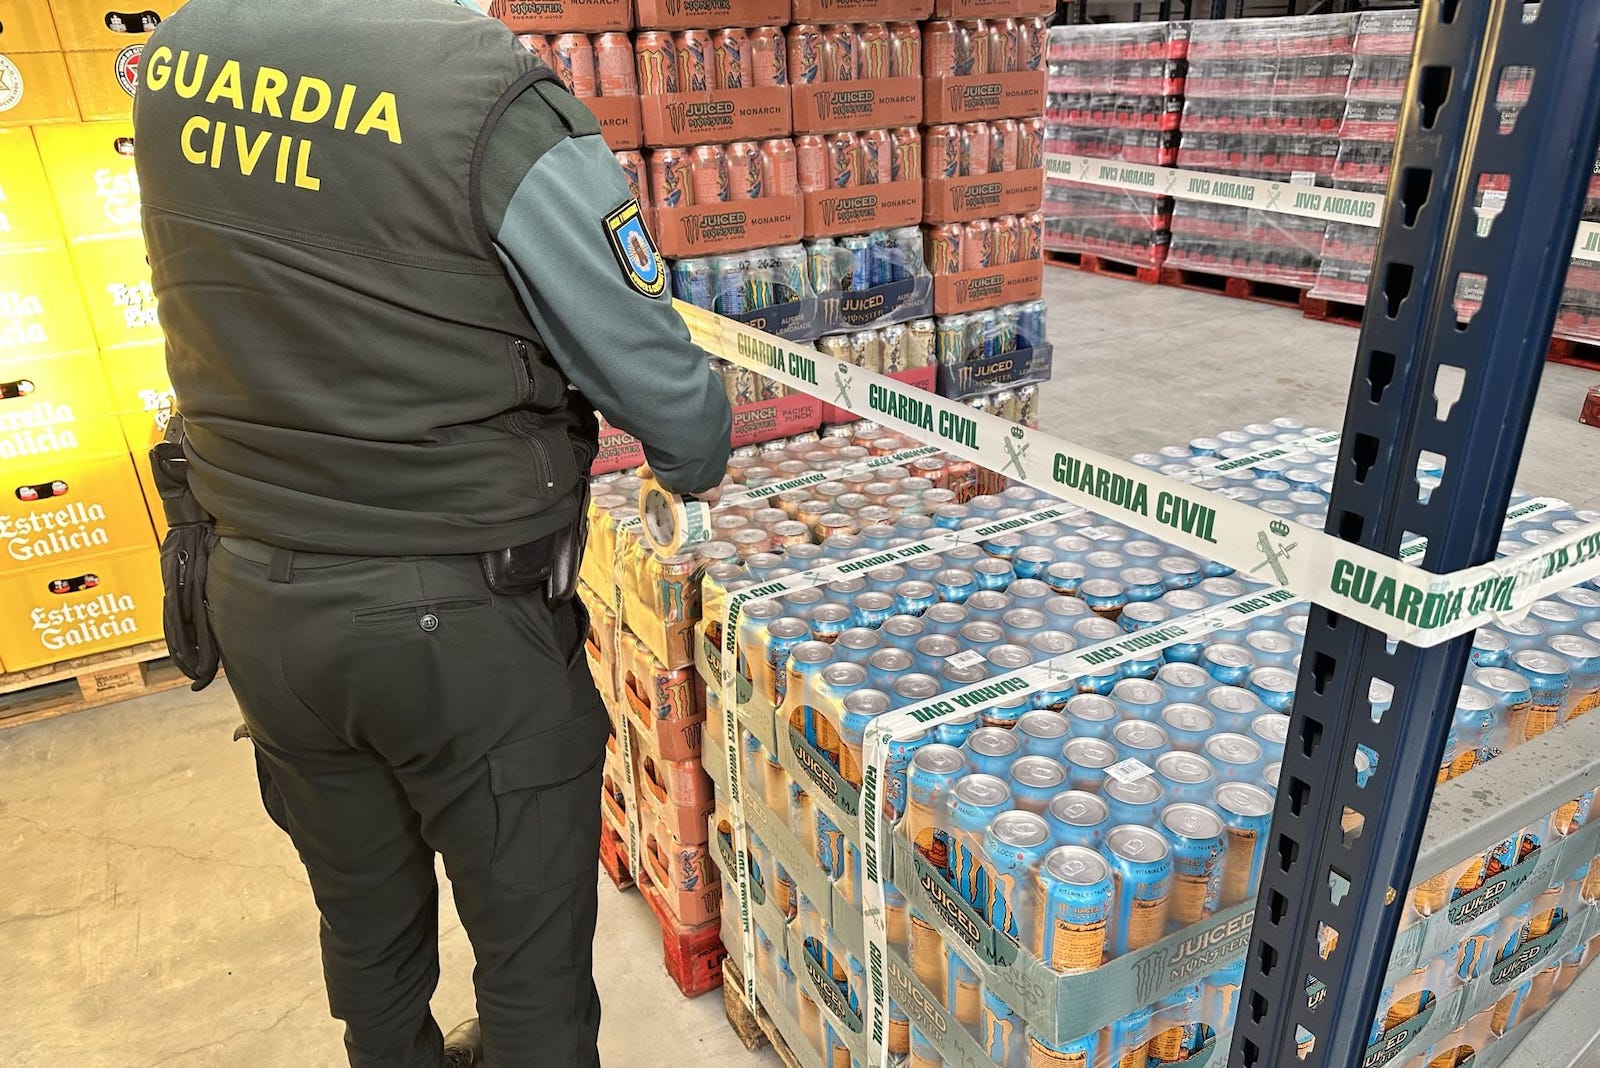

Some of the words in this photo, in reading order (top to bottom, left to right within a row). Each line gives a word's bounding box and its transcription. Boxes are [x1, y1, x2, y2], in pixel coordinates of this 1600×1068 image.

[510, 3, 564, 14] MONSTER
[146, 46, 402, 144] GUARDIA
[831, 90, 874, 104] JUICED
[879, 96, 916, 104] MONARCH
[963, 84, 1002, 98] JUICED
[1006, 89, 1039, 97] MONARCH
[685, 102, 735, 116] JUICED
[740, 106, 781, 116] MONARCH
[688, 117, 733, 128] MONSTER
[180, 115, 321, 191] CIVIL
[965, 183, 1002, 197] JUICED
[1006, 186, 1038, 195] MONARCH
[837, 196, 877, 211] JUICED
[882, 199, 917, 208] MONARCH
[700, 212, 746, 228] JUICED
[752, 215, 791, 225] MONARCH
[968, 274, 1004, 290] JUICED
[1007, 276, 1038, 286] MONARCH
[842, 295, 884, 311] JUICED
[891, 299, 925, 311] LEMONADE
[781, 313, 805, 325] AUSSIE
[843, 309, 884, 324] MONSTER
[775, 322, 812, 336] LEMONADE
[736, 332, 786, 373] GUARDIA
[788, 352, 818, 386] CIVIL
[974, 360, 1014, 377] JUICED
[734, 407, 777, 425] PUNCH
[783, 405, 814, 417] PACIFIC
[785, 413, 812, 423] PUNCH
[869, 383, 934, 432] GUARDIA
[938, 413, 980, 450] CIVIL
[746, 488, 777, 499] CIVIL
[777, 473, 828, 493] GUARDIA
[1052, 452, 1149, 518] GUARDIA
[1155, 490, 1218, 544] CIVIL
[0, 502, 107, 539] Estrella
[975, 517, 1029, 536] GUARDIA
[1030, 509, 1065, 524] CIVIL
[8, 525, 110, 561] Galicia
[837, 550, 898, 575] GUARDIA
[898, 543, 935, 558] CIVIL
[1227, 594, 1271, 615] CIVIL
[1330, 558, 1466, 630] GUARDIA
[1467, 576, 1518, 616] CIVIL
[31, 593, 136, 631] Estrella
[726, 593, 752, 655] GUARDIA
[750, 582, 791, 599] CIVIL
[41, 615, 139, 650] Galicia
[1122, 624, 1190, 651] GUARDIA
[1076, 644, 1122, 666] CIVIL
[952, 676, 1030, 708] GUARDIA
[906, 701, 955, 723] CIVIL
[796, 747, 838, 794] JUICED
[864, 764, 877, 843] GUARDIA
[864, 843, 879, 884] CIVIL
[921, 875, 982, 943] JUICED
[1171, 910, 1256, 963] JUICED
[1169, 933, 1250, 982] MONSTER
[869, 940, 883, 1007] GUARDIA
[806, 963, 846, 1018] JUICED
[888, 960, 947, 1033] JUICED
[871, 1005, 884, 1046] CIVIL
